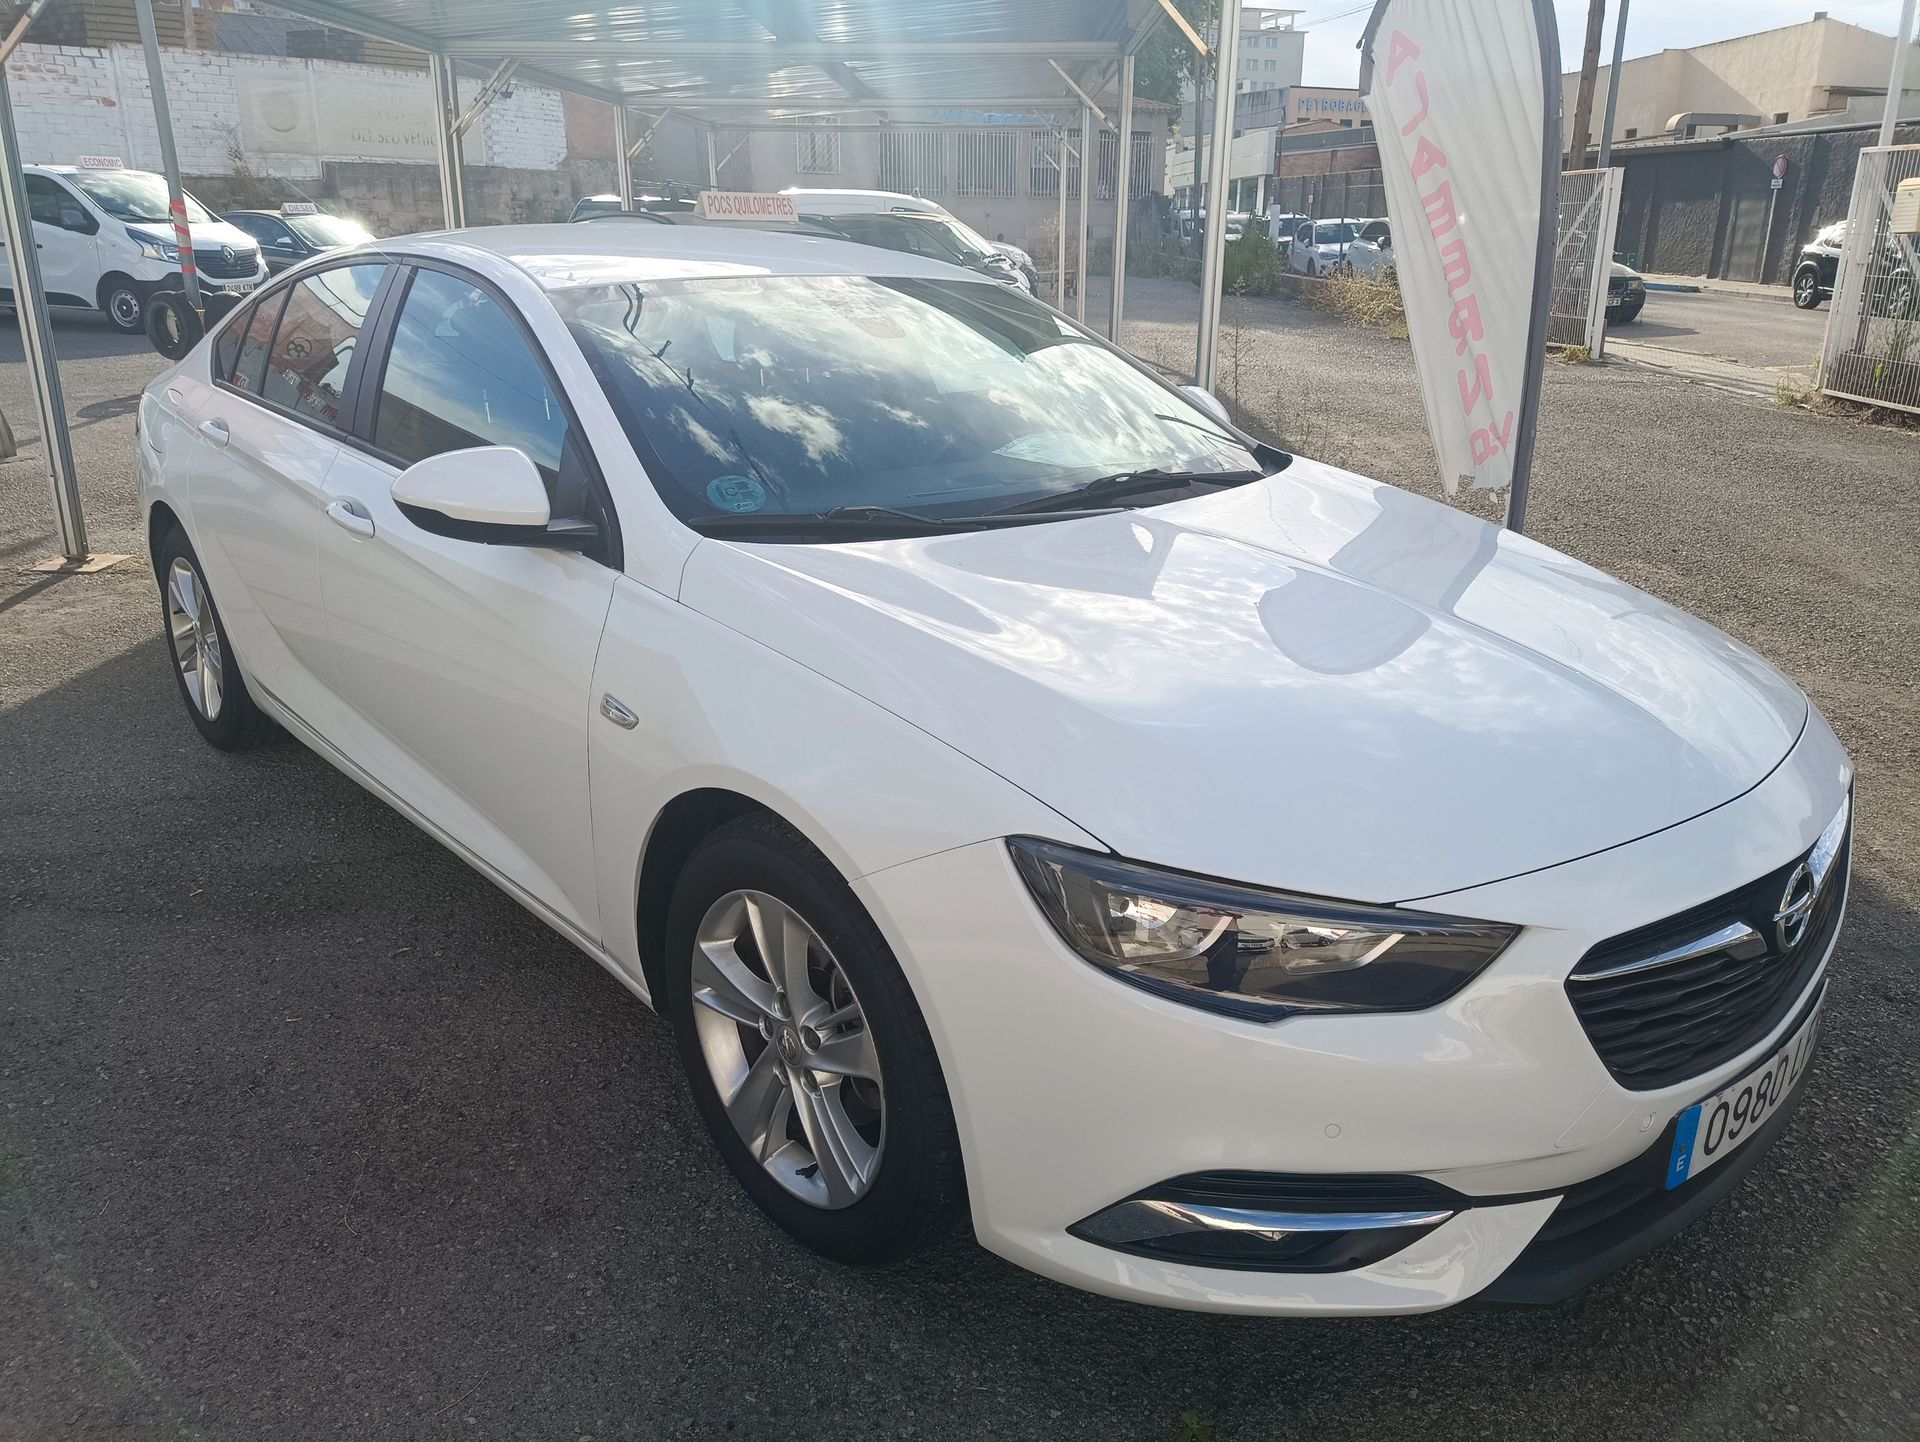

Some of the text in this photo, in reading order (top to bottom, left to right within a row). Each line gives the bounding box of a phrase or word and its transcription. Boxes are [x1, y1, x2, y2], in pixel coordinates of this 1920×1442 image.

[403, 132, 438, 146] VEHIC
[82, 156, 123, 168] ECONOMIC
[288, 203, 315, 212] DIESEL
[707, 195, 794, 216] POCS QUILOMETRES
[1703, 1053, 1790, 1157] 0980
